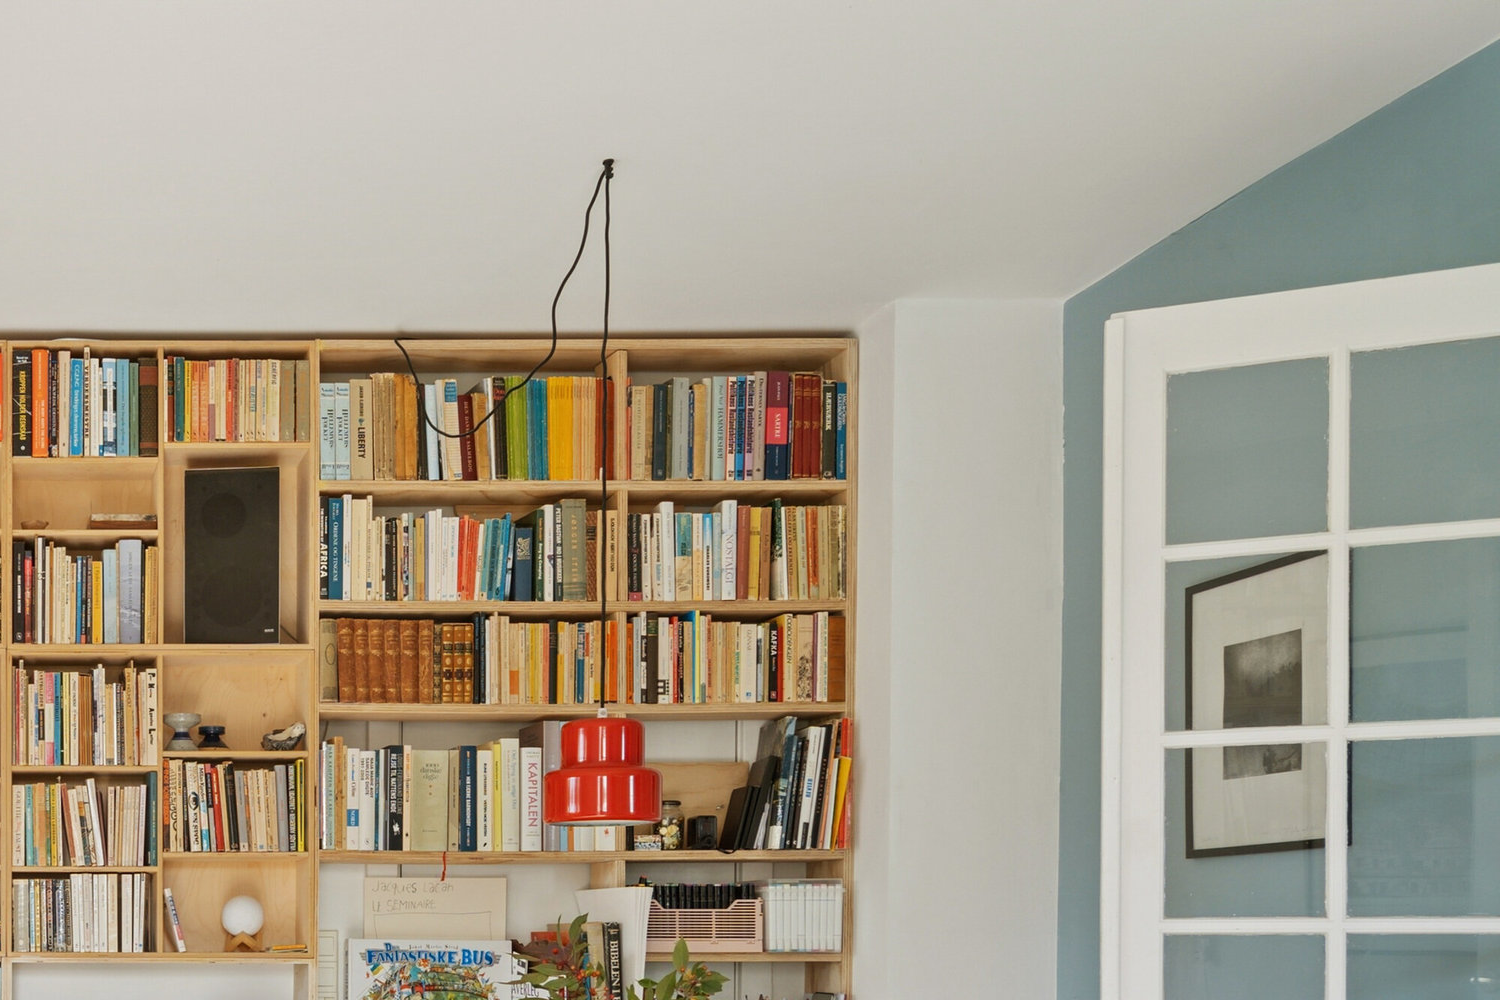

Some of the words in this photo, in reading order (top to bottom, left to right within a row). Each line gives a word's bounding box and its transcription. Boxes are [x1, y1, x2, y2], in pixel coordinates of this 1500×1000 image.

[18, 370, 26, 394] KROPPEN
[728, 380, 736, 408] Politikens
[736, 380, 744, 408] Politikens
[746, 380, 754, 408] Politikens
[774, 414, 782, 438] SARTRE
[358, 427, 366, 459] LIBERTY
[554, 508, 562, 522] PETER
[725, 534, 734, 584] NOSTALGI
[528, 762, 538, 828] KAPITALEN
[372, 882, 417, 895] Jacques
[386, 899, 436, 912] SEMINAIRE
[461, 948, 494, 966] BUS
[610, 940, 621, 986] BIBELEN
